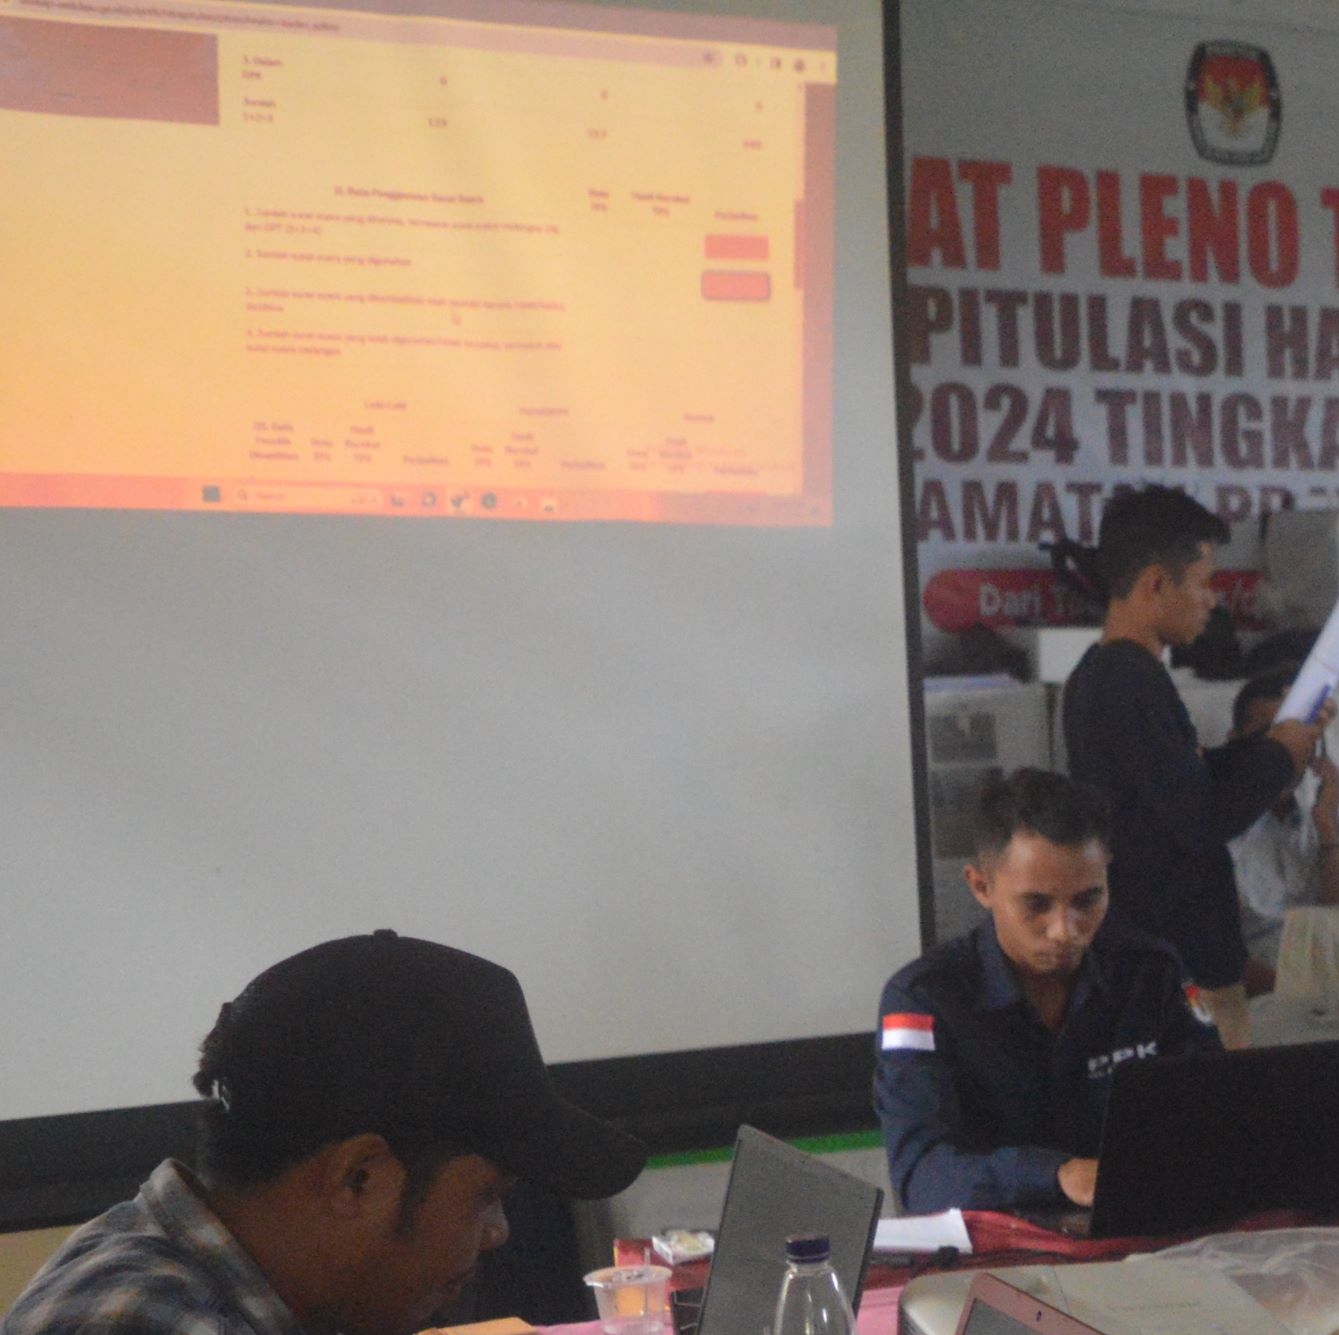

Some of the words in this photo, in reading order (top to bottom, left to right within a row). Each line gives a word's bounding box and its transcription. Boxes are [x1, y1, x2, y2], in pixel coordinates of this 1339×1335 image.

[906, 156, 1012, 270] AT
[1037, 165, 1300, 289] PLENO
[906, 285, 1244, 377] PITULASI
[916, 478, 1186, 543] AMAT
